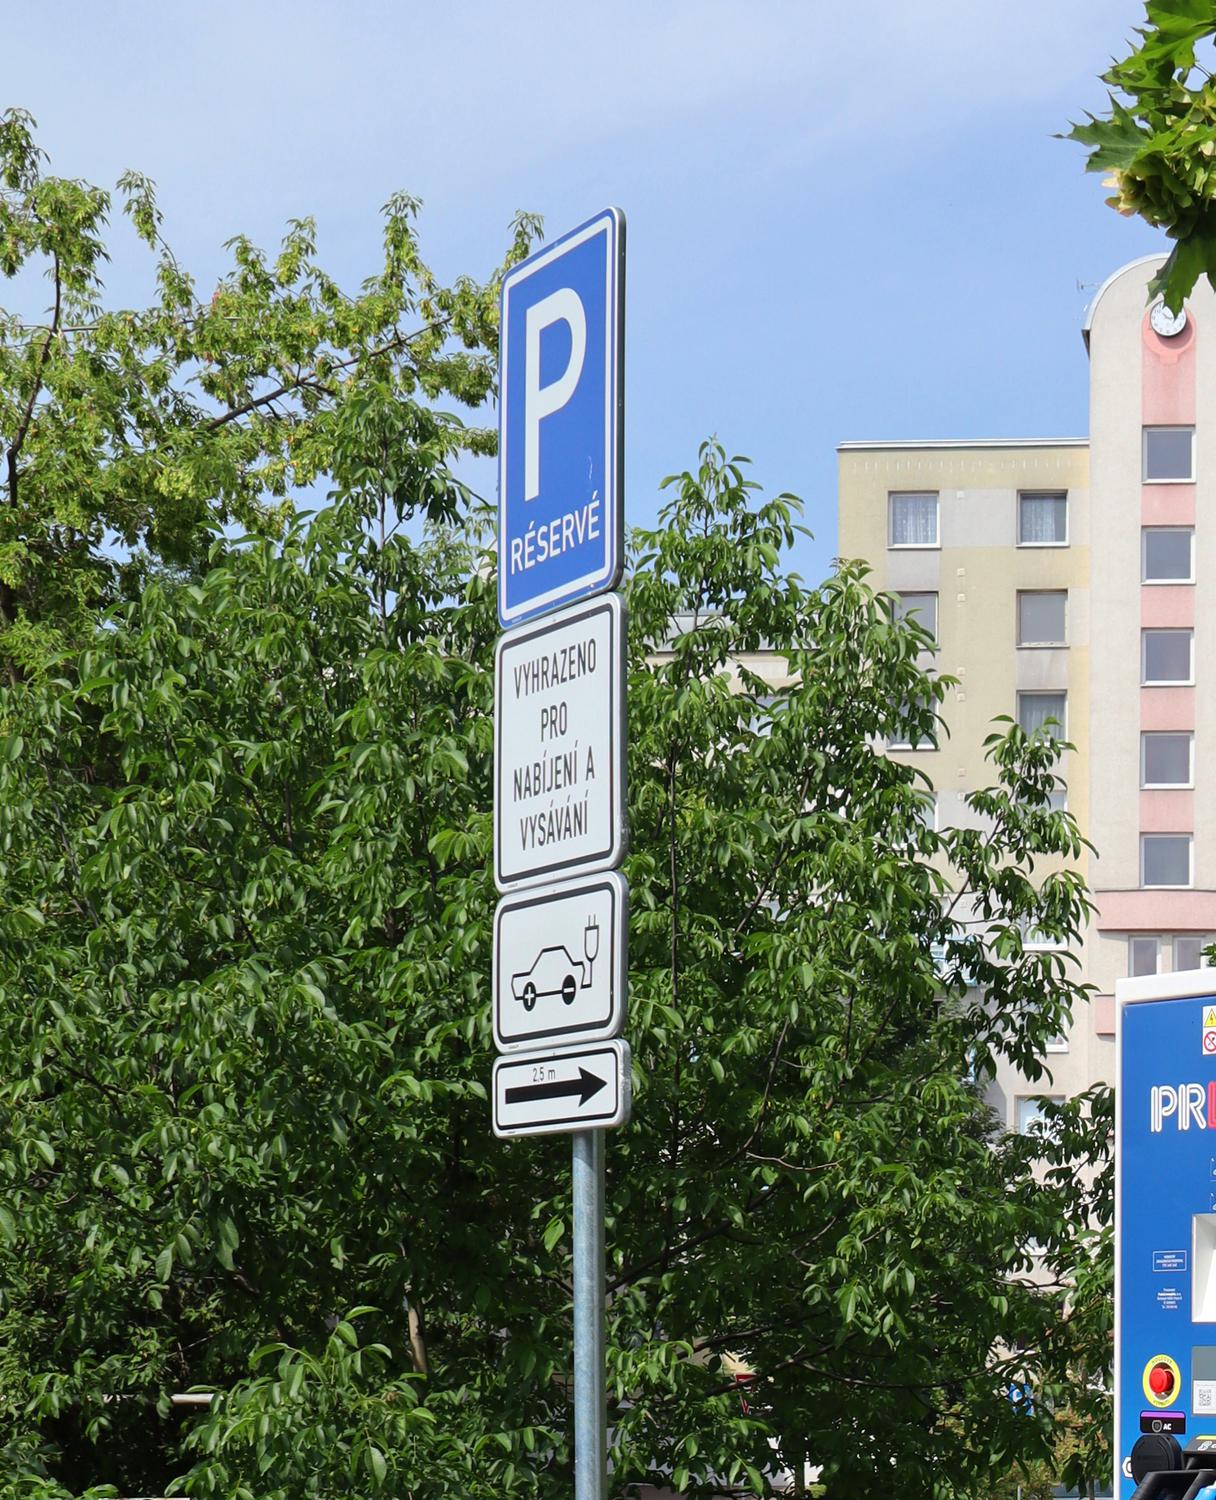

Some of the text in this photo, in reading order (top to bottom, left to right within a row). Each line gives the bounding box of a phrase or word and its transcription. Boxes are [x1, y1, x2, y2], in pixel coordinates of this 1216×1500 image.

[525, 287, 587, 502] P
[510, 490, 601, 575] RÉSERVÉ
[514, 638, 597, 699] VYHRAZENO
[541, 700, 568, 742] PRO
[513, 739, 595, 803] NABÍJENÍ A
[519, 788, 589, 852] VYSÁVÁNÍ
[1162, 1423, 1172, 1431] AC
